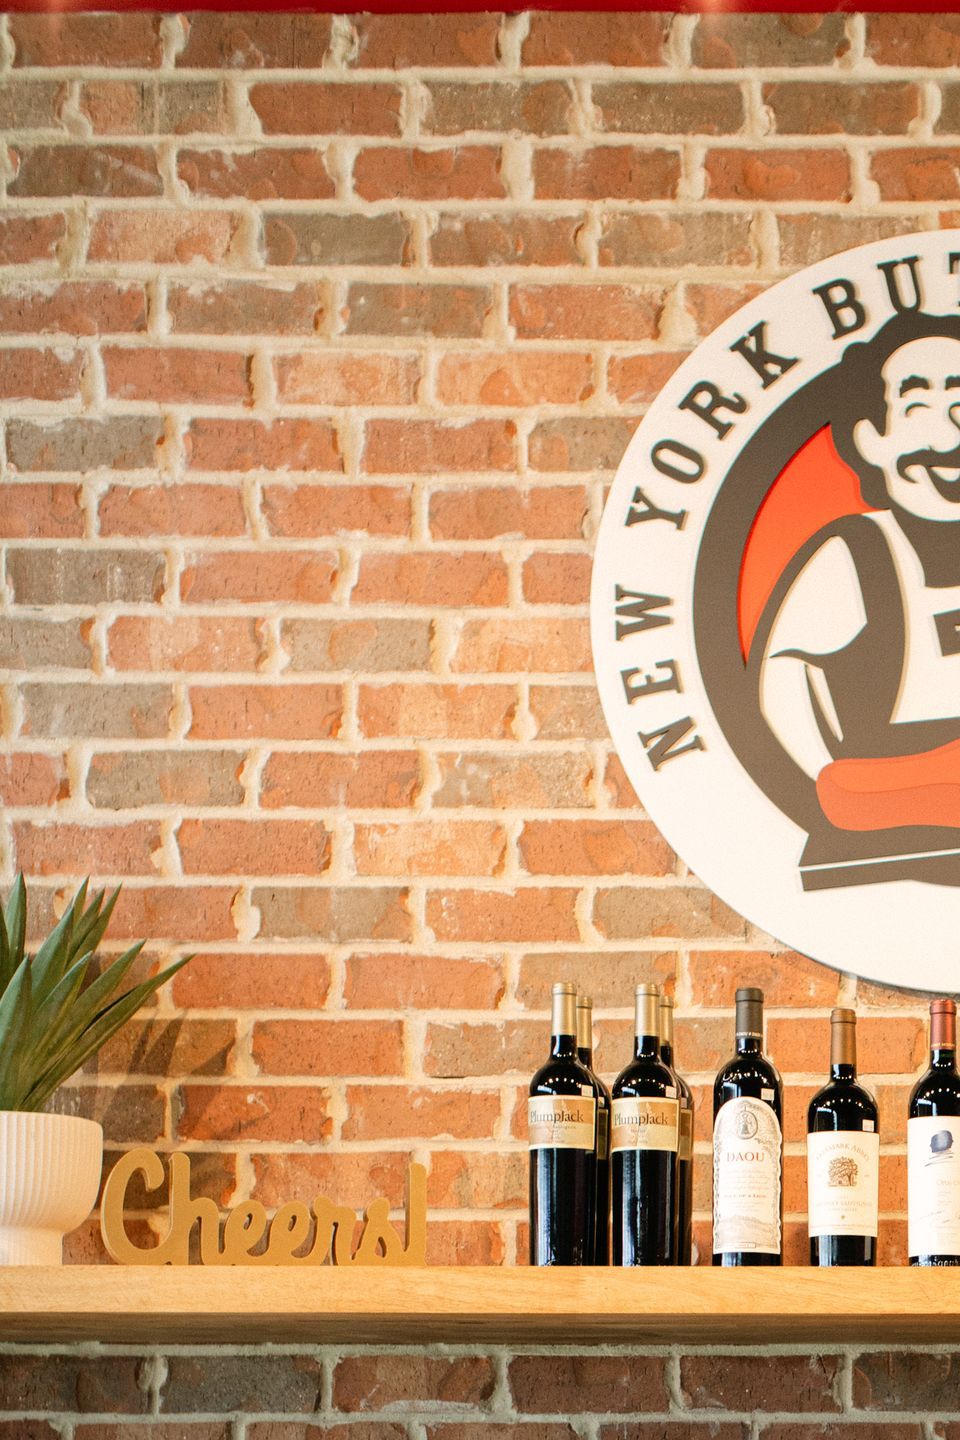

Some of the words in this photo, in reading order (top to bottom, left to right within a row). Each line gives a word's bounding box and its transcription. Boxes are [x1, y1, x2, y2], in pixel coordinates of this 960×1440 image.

[625, 320, 800, 532] YORK
[614, 584, 704, 772] NEW
[100, 1147, 429, 1266] Cheers!
[726, 1151, 766, 1163] DAOU
